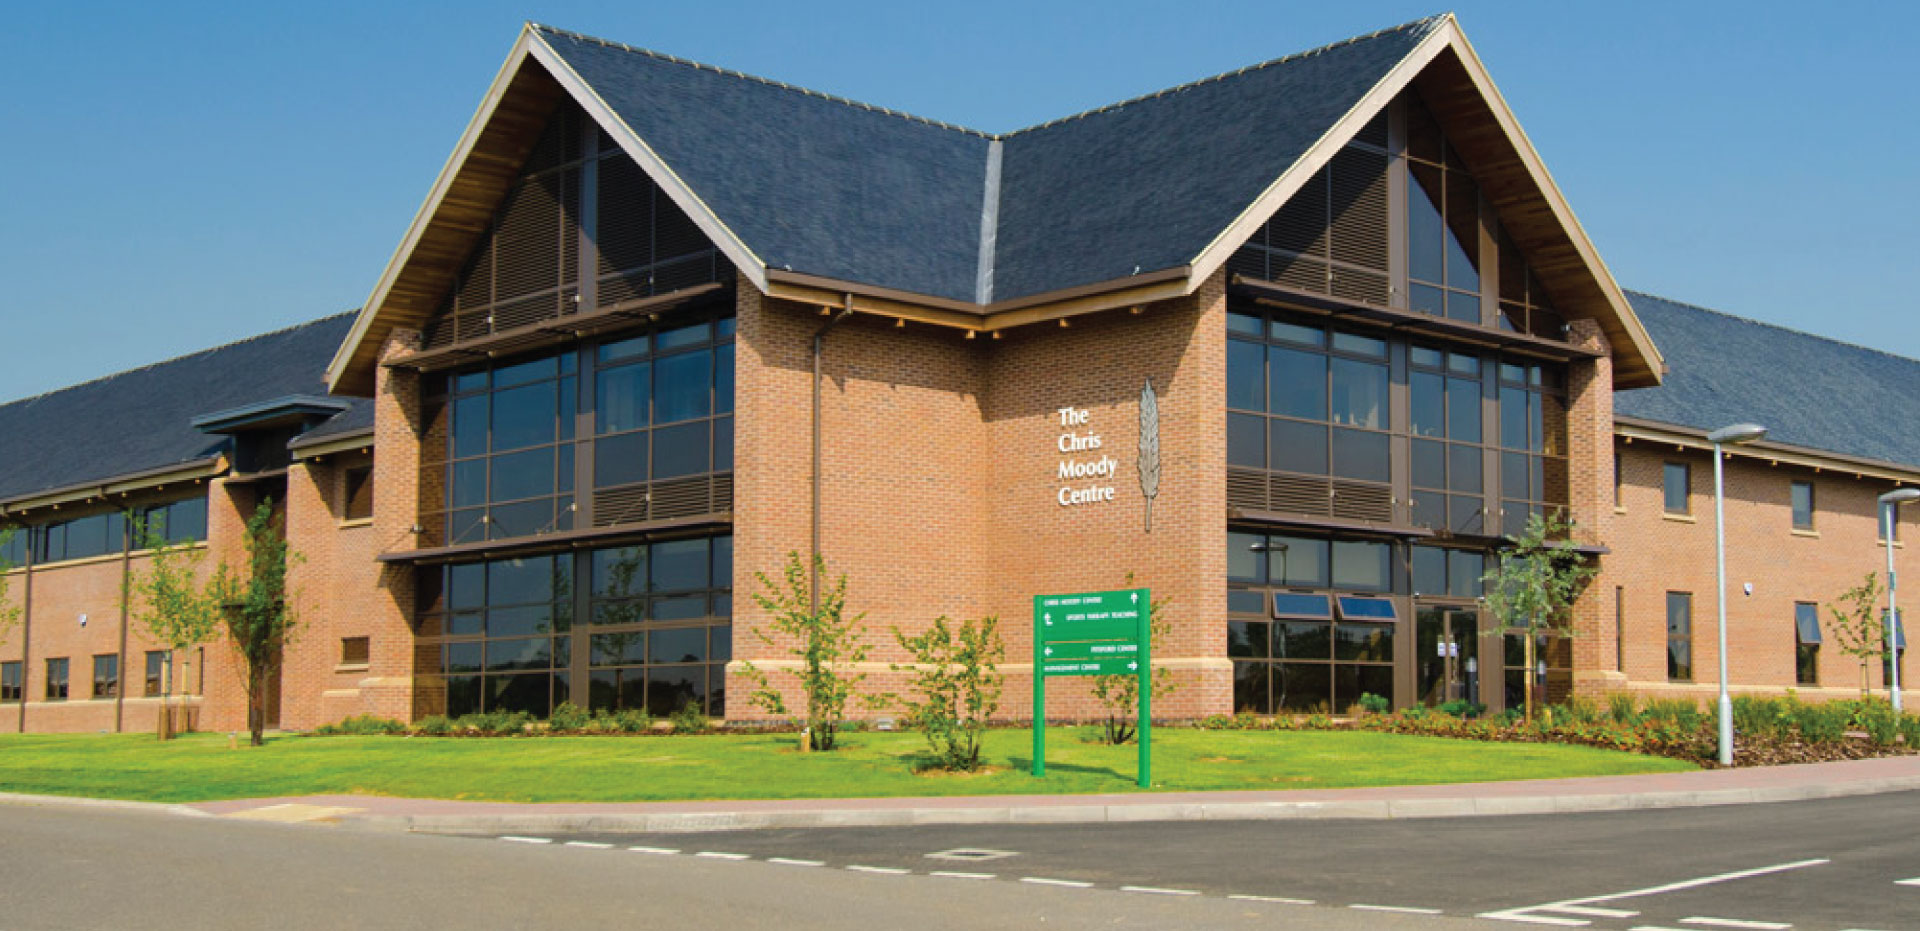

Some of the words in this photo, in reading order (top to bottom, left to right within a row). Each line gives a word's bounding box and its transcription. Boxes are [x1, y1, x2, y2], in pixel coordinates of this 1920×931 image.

[1058, 407, 1089, 426] The
[1058, 430, 1102, 452] Chris
[1058, 455, 1118, 479] Moody
[1058, 484, 1115, 506] Centre
